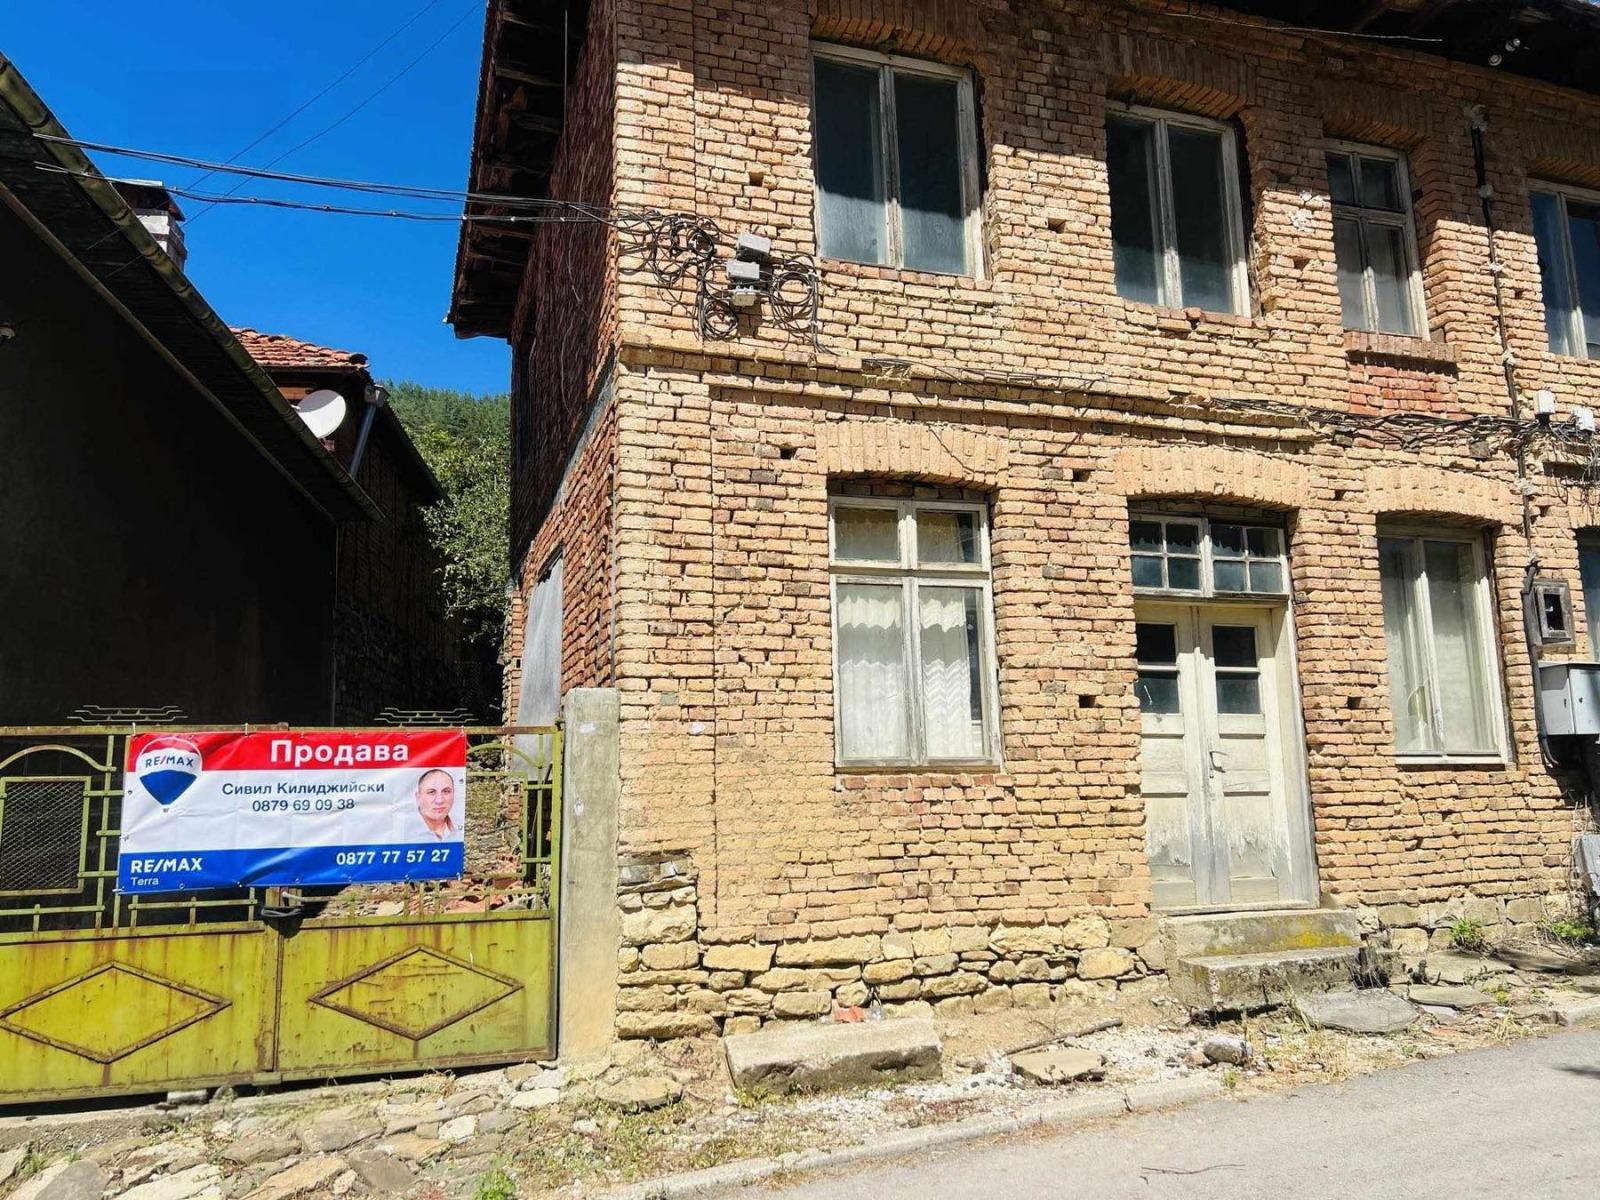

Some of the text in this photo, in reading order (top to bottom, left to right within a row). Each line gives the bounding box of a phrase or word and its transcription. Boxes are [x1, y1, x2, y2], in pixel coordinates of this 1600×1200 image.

[271, 740, 409, 767] Продава
[145, 755, 194, 768] RE/MAX
[222, 781, 385, 796] Сивил Килиджийски
[252, 798, 354, 812] 0879 69 09 38
[336, 849, 449, 865] 0877 77 57 27
[131, 857, 202, 874] RE/MAX
[131, 876, 159, 886] Terra
